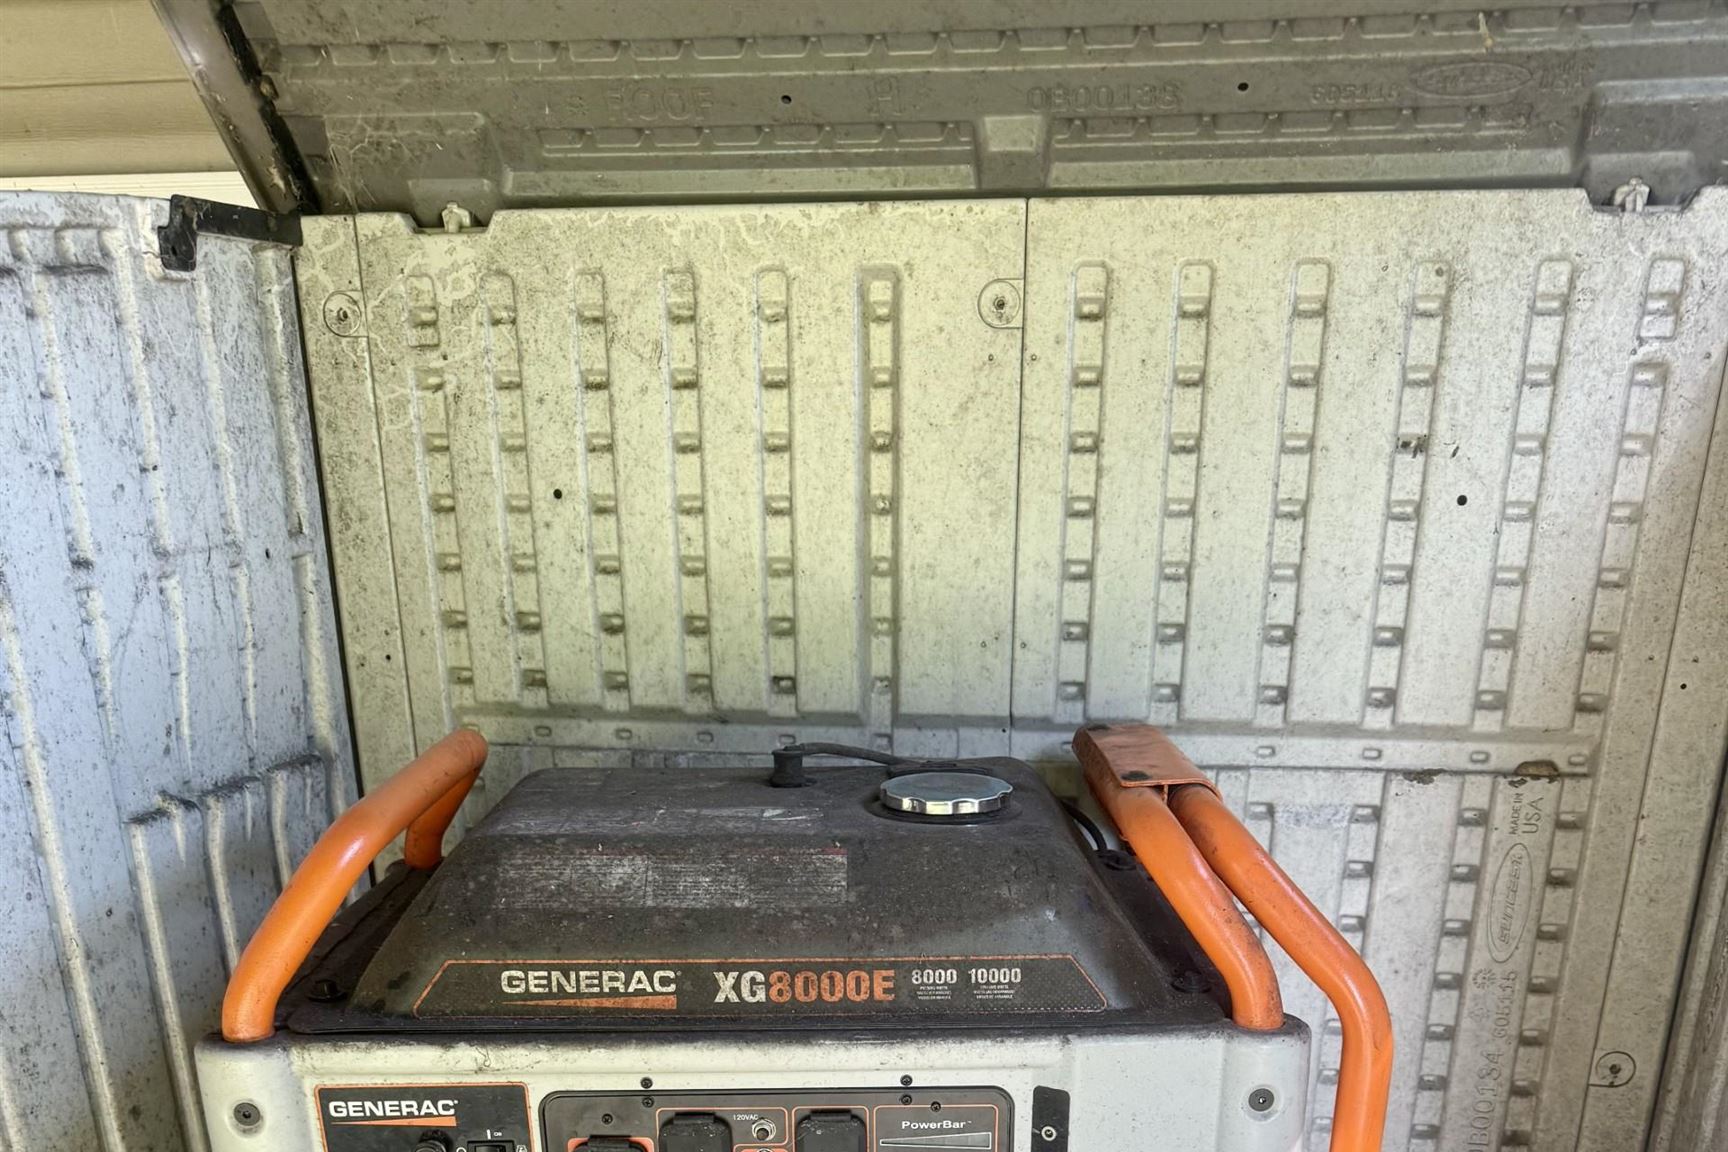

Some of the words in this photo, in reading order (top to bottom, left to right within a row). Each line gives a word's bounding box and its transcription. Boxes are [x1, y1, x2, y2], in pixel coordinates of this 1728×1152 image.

[604, 85, 715, 122] ROOF
[1513, 792, 1523, 804] IN
[1508, 805, 1521, 835] MADE
[1522, 796, 1544, 834] USA
[500, 969, 678, 995] GENERAC
[713, 969, 895, 1003] XG8000E
[911, 968, 957, 985] 8000
[967, 967, 1021, 984] 10000
[328, 1099, 456, 1118] GENERAC
[901, 1120, 966, 1130] PowerBar
